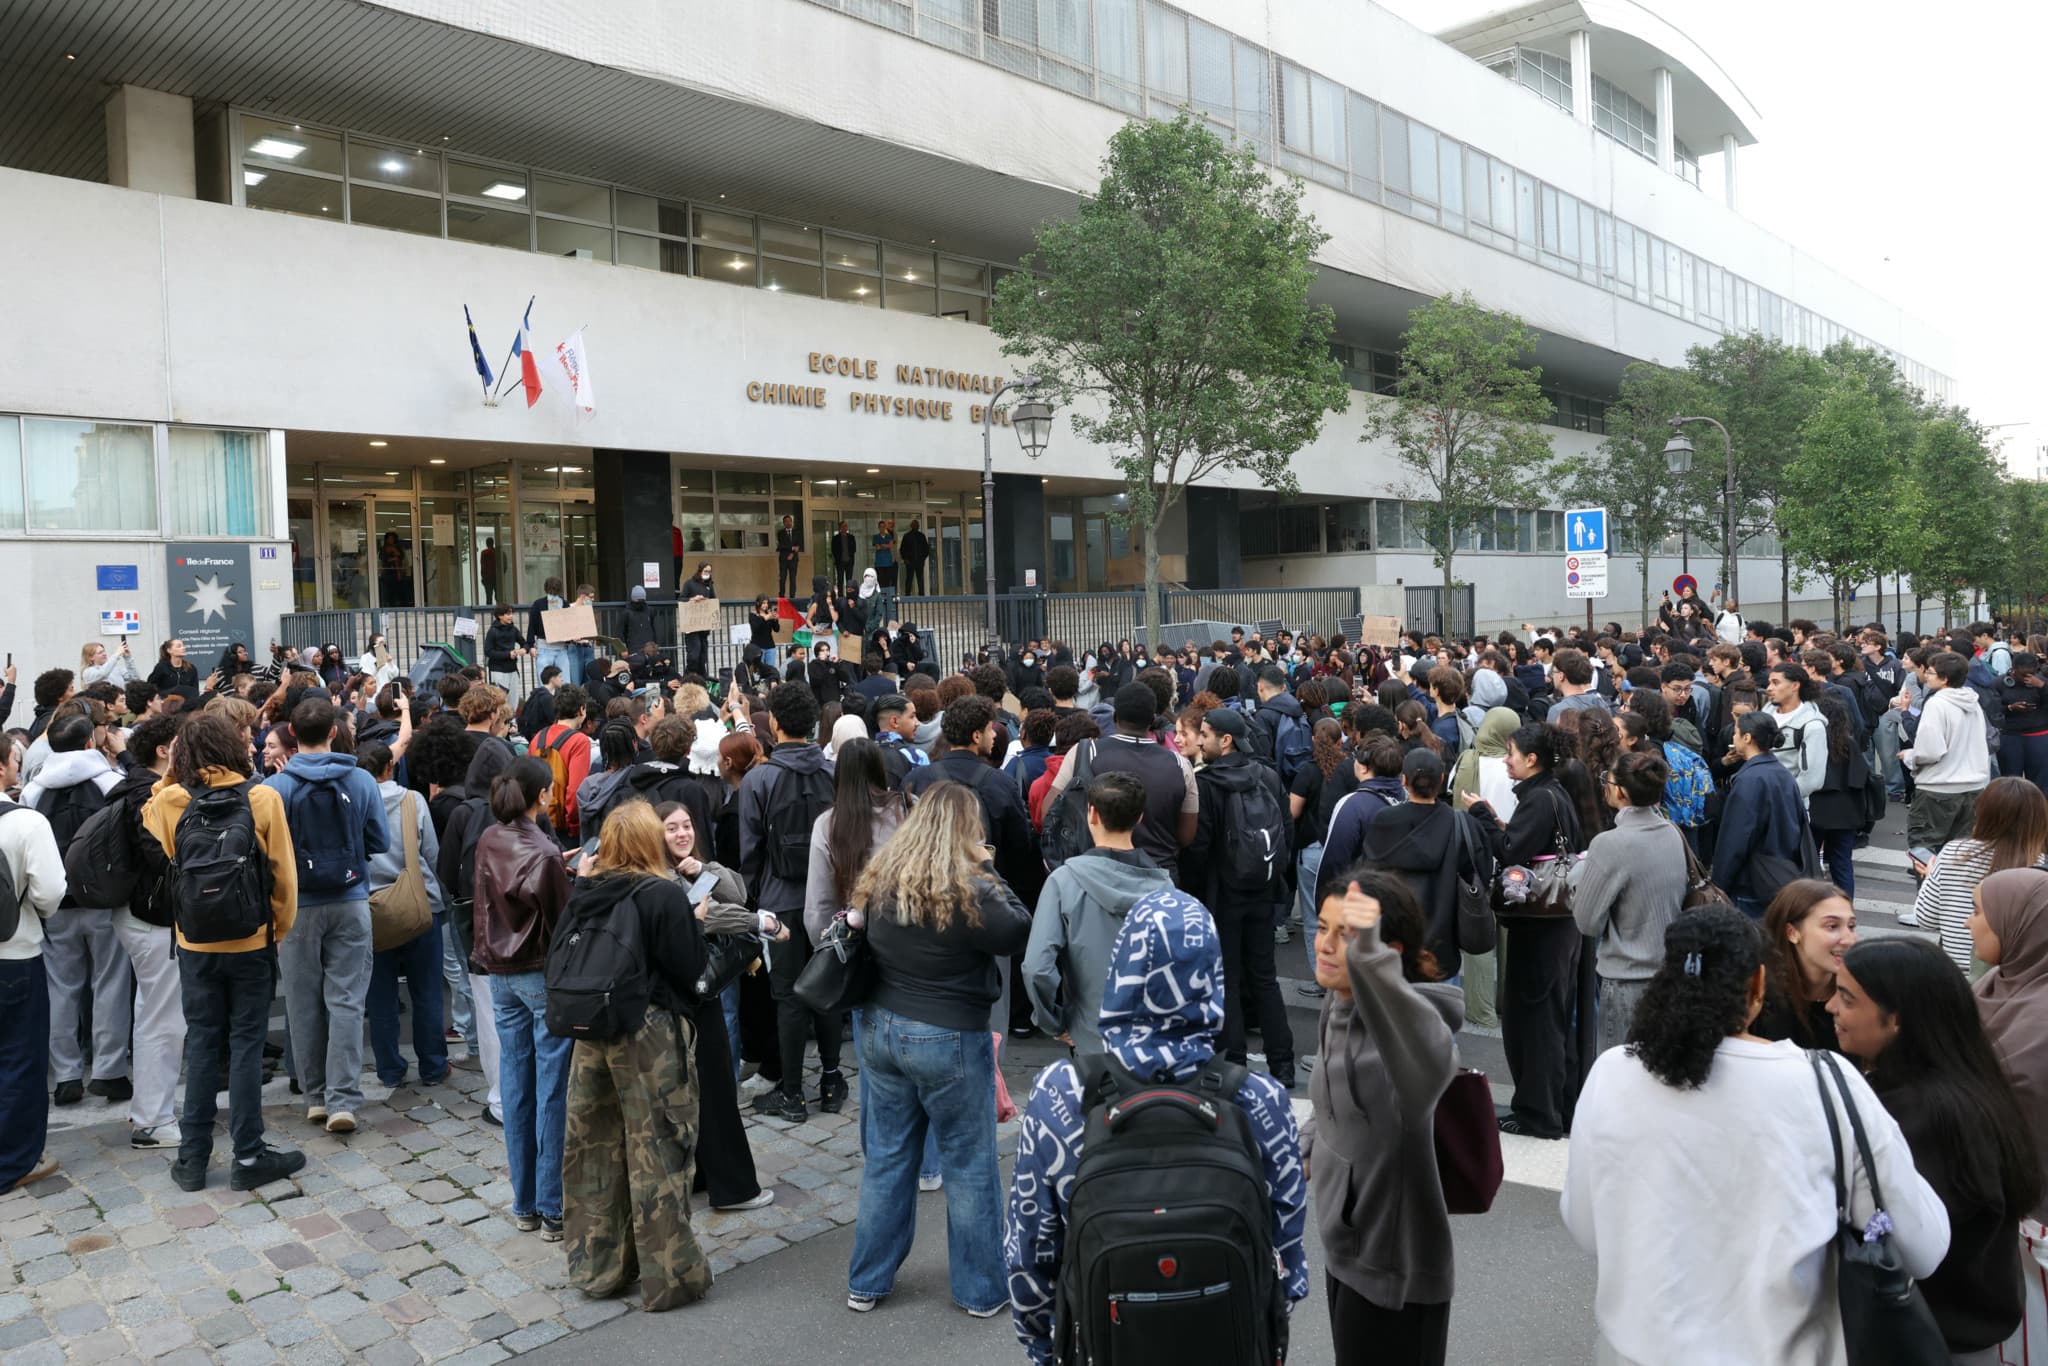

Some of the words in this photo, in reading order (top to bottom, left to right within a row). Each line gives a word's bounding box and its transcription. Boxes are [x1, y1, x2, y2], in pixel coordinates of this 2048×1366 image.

[808, 352, 878, 380] ECOLE
[897, 364, 1004, 394] NATIONALE
[747, 381, 827, 408] CHIMIE
[850, 392, 953, 421] PHYSIQUE
[1181, 900, 1204, 949] NIKE
[1048, 1085, 1073, 1127] nike
[1244, 1087, 1274, 1131] nike
